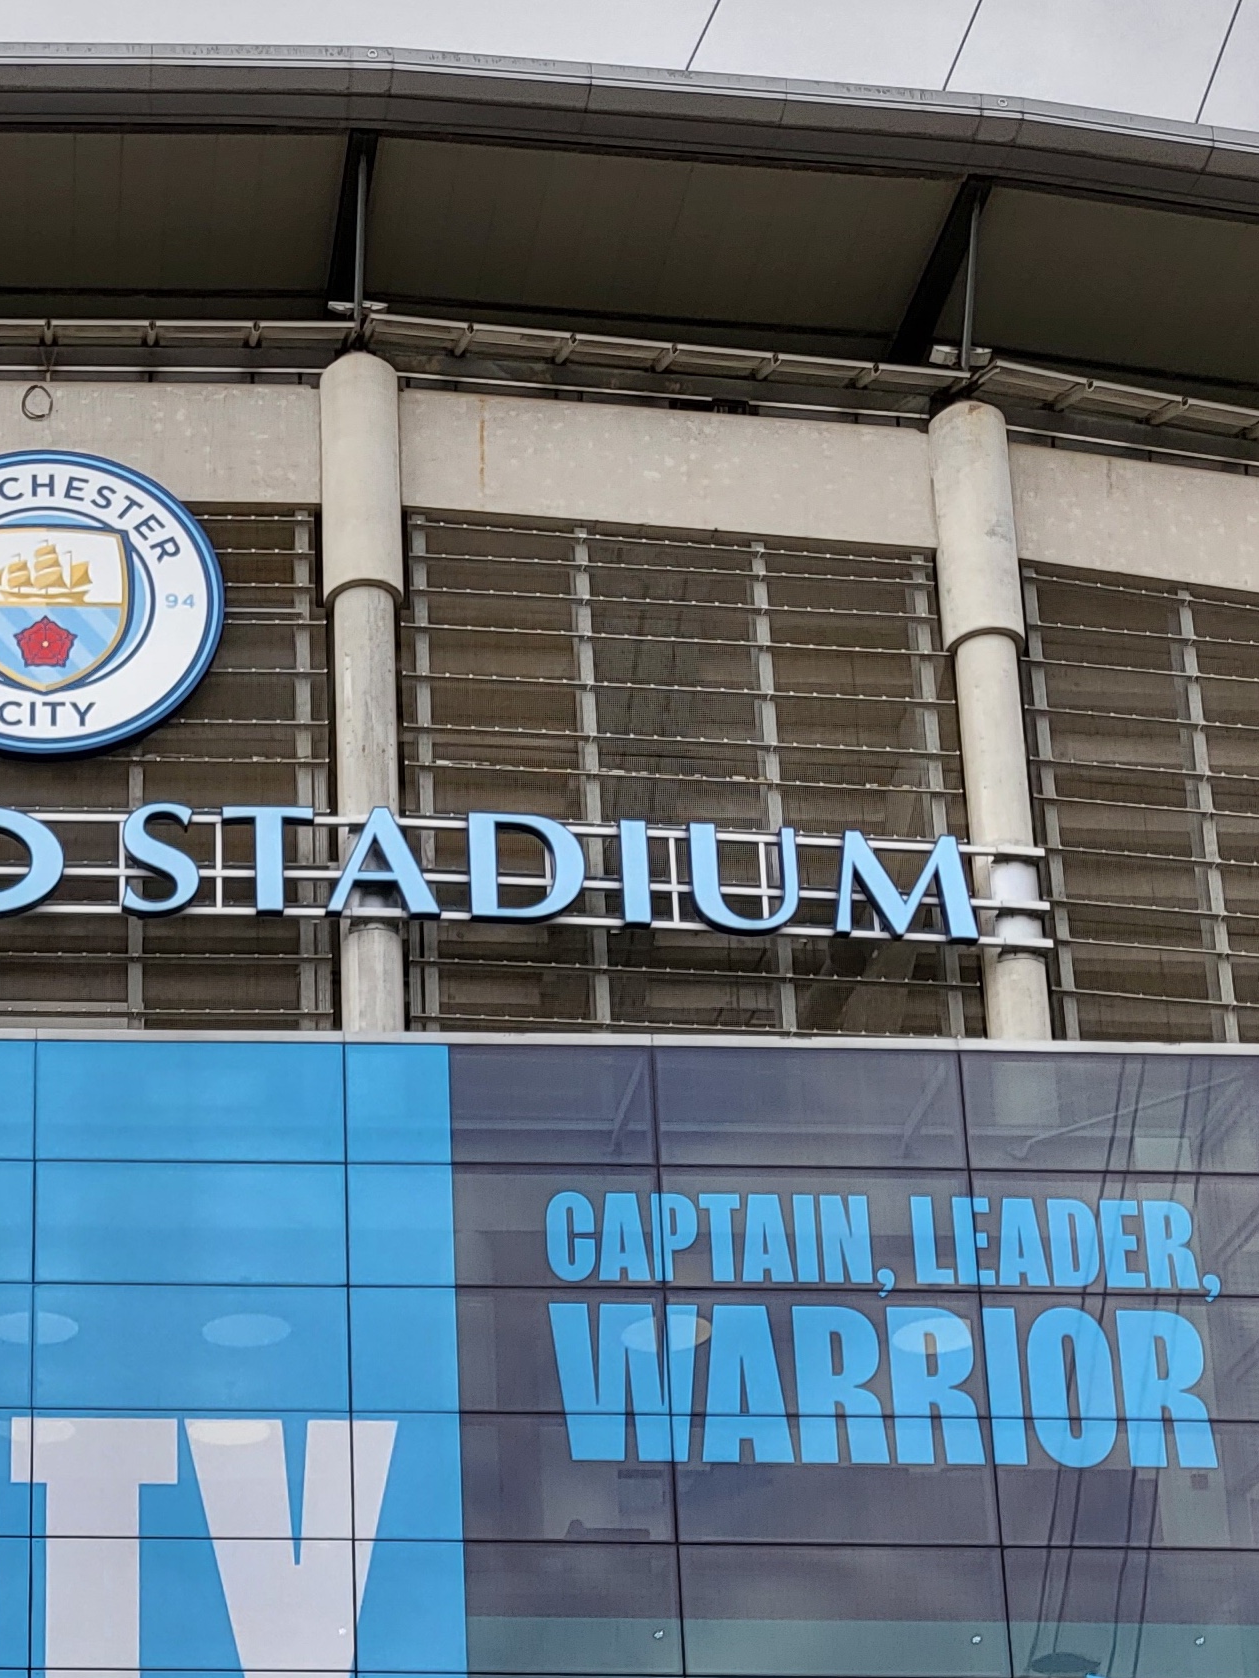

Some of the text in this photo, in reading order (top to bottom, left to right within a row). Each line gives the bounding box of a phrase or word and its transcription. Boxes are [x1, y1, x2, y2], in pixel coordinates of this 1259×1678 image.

[165, 593, 195, 609] 94
[121, 802, 979, 944] STADIUM
[545, 1191, 1221, 1302] CAPTAIN, LEADER,
[548, 1302, 1219, 1468] WARRIOR
